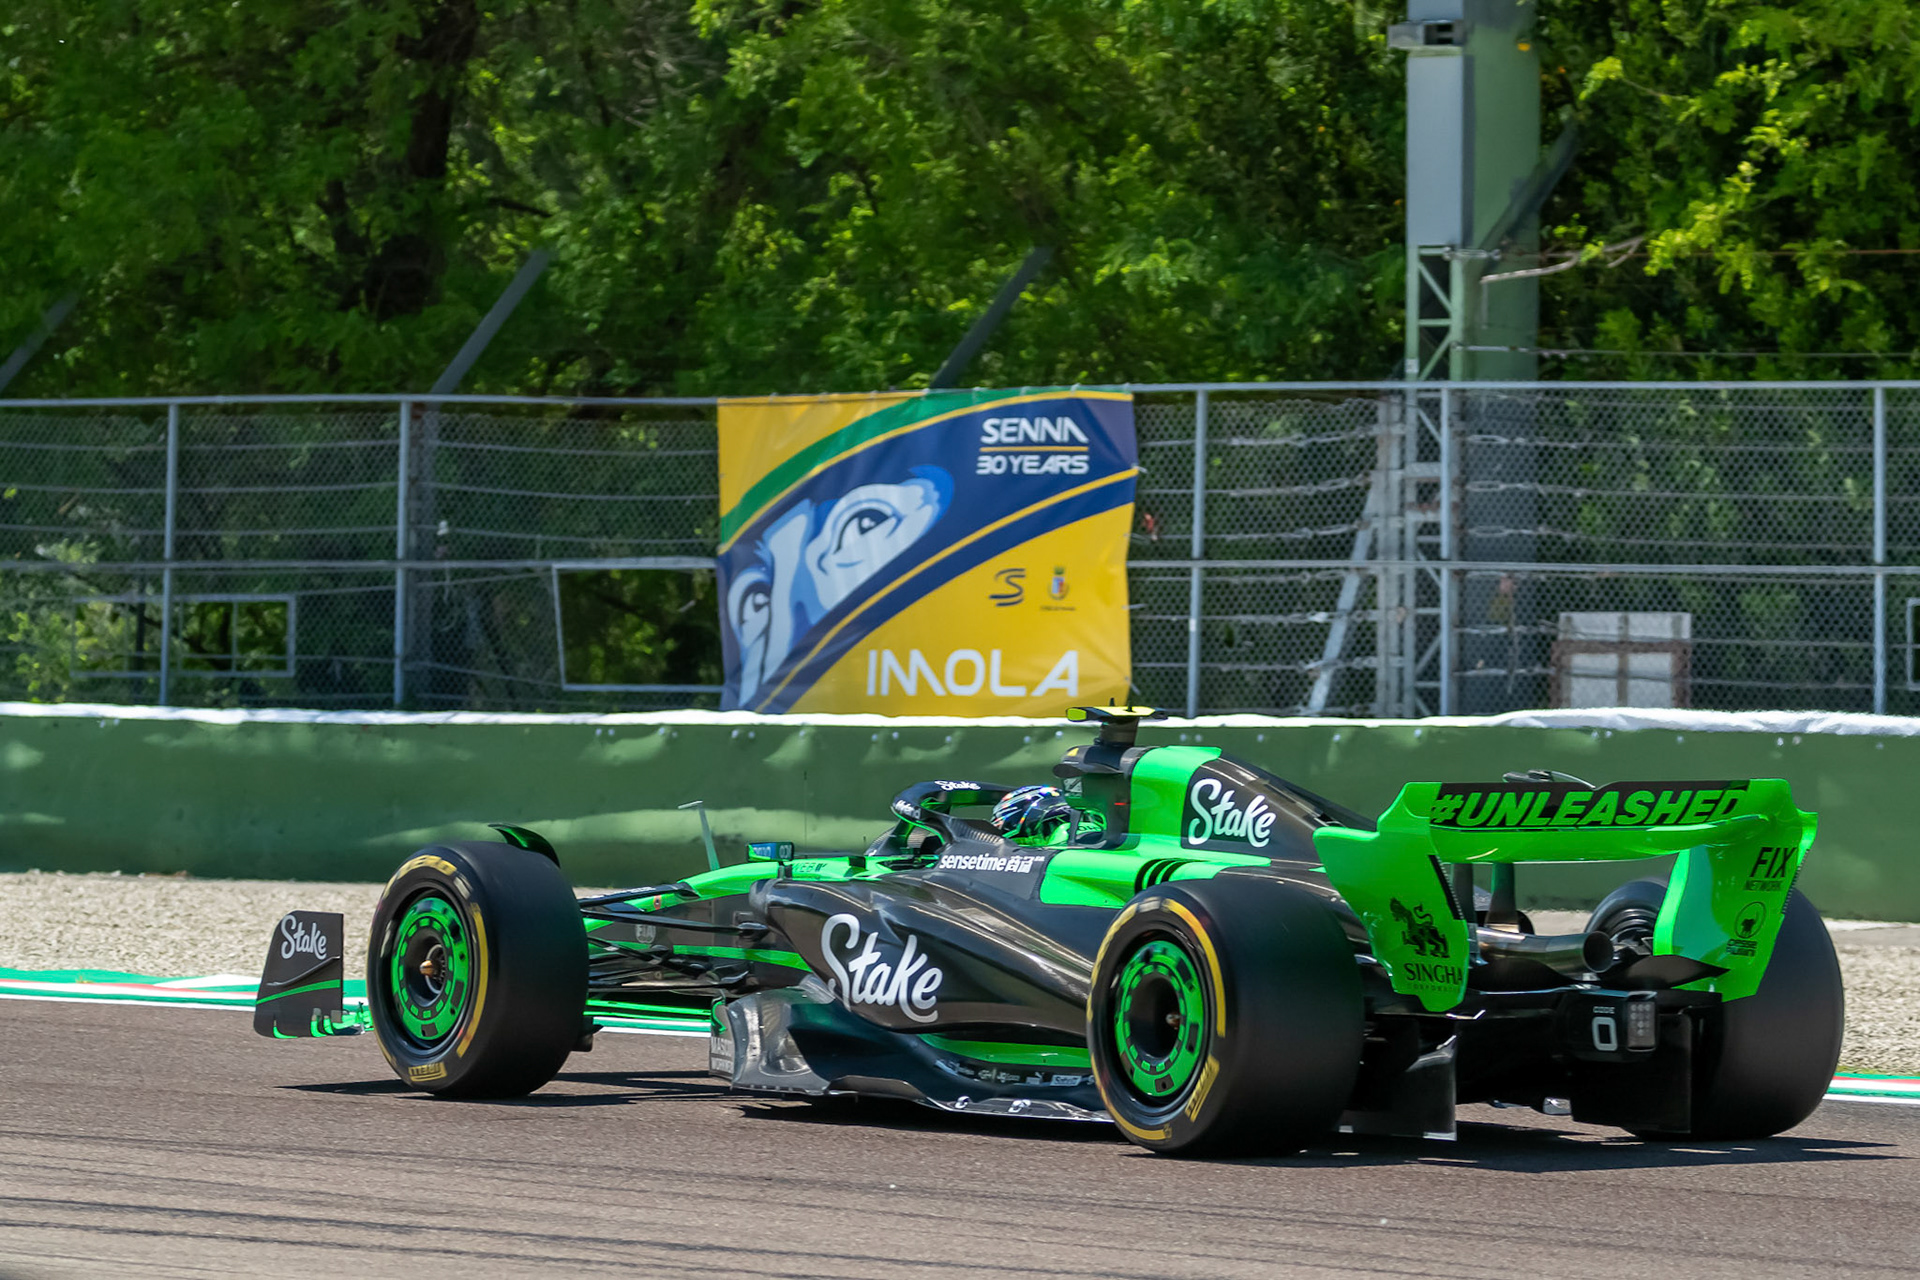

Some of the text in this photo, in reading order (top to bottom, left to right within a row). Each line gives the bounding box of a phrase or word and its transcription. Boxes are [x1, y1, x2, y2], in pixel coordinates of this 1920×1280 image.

[980, 416, 1089, 444] SENNA
[976, 455, 1090, 475] 30 YEARS
[866, 649, 1079, 697] IMOLA
[934, 780, 981, 791] Stake
[1187, 777, 1276, 849] Stake
[1430, 789, 1748, 827] #UNLEASHED
[1749, 846, 1798, 878] FIX
[280, 914, 327, 960] Stake
[820, 912, 944, 1024] Stake
[1403, 962, 1464, 986] SINGHA
